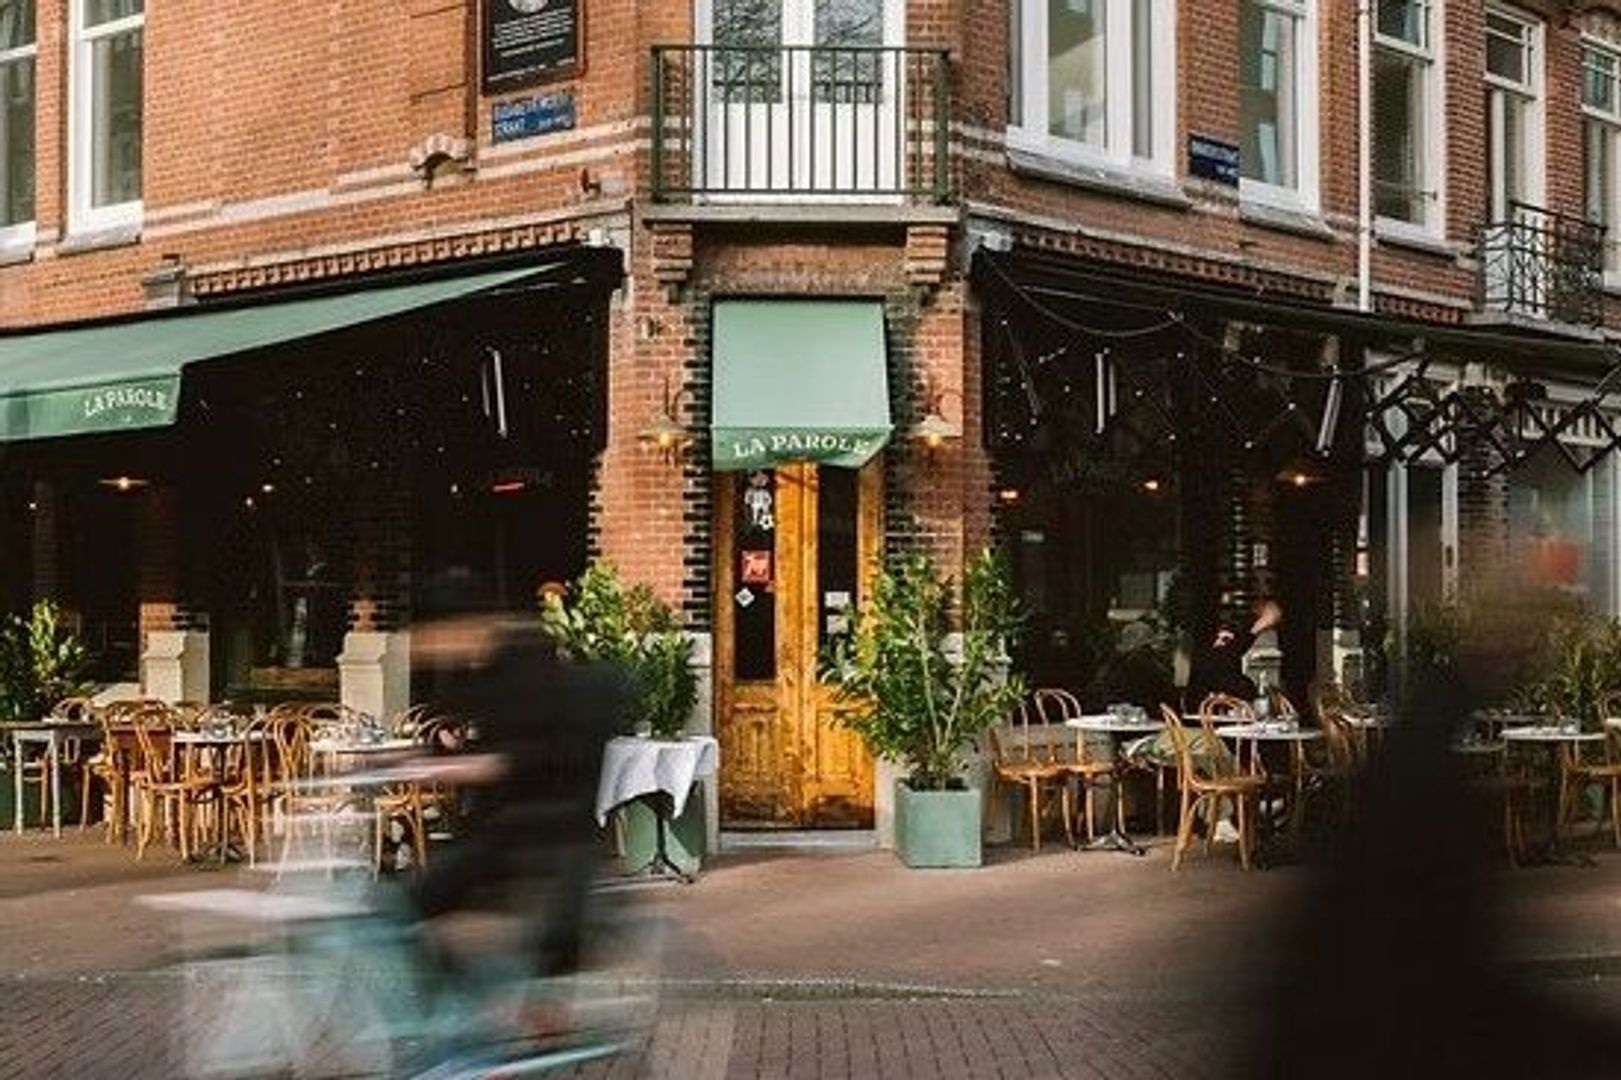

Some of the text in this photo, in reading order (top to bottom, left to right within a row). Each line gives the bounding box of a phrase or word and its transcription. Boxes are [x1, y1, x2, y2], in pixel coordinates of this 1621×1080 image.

[84, 397, 105, 417] LA
[733, 434, 870, 458] LA PAROLE
